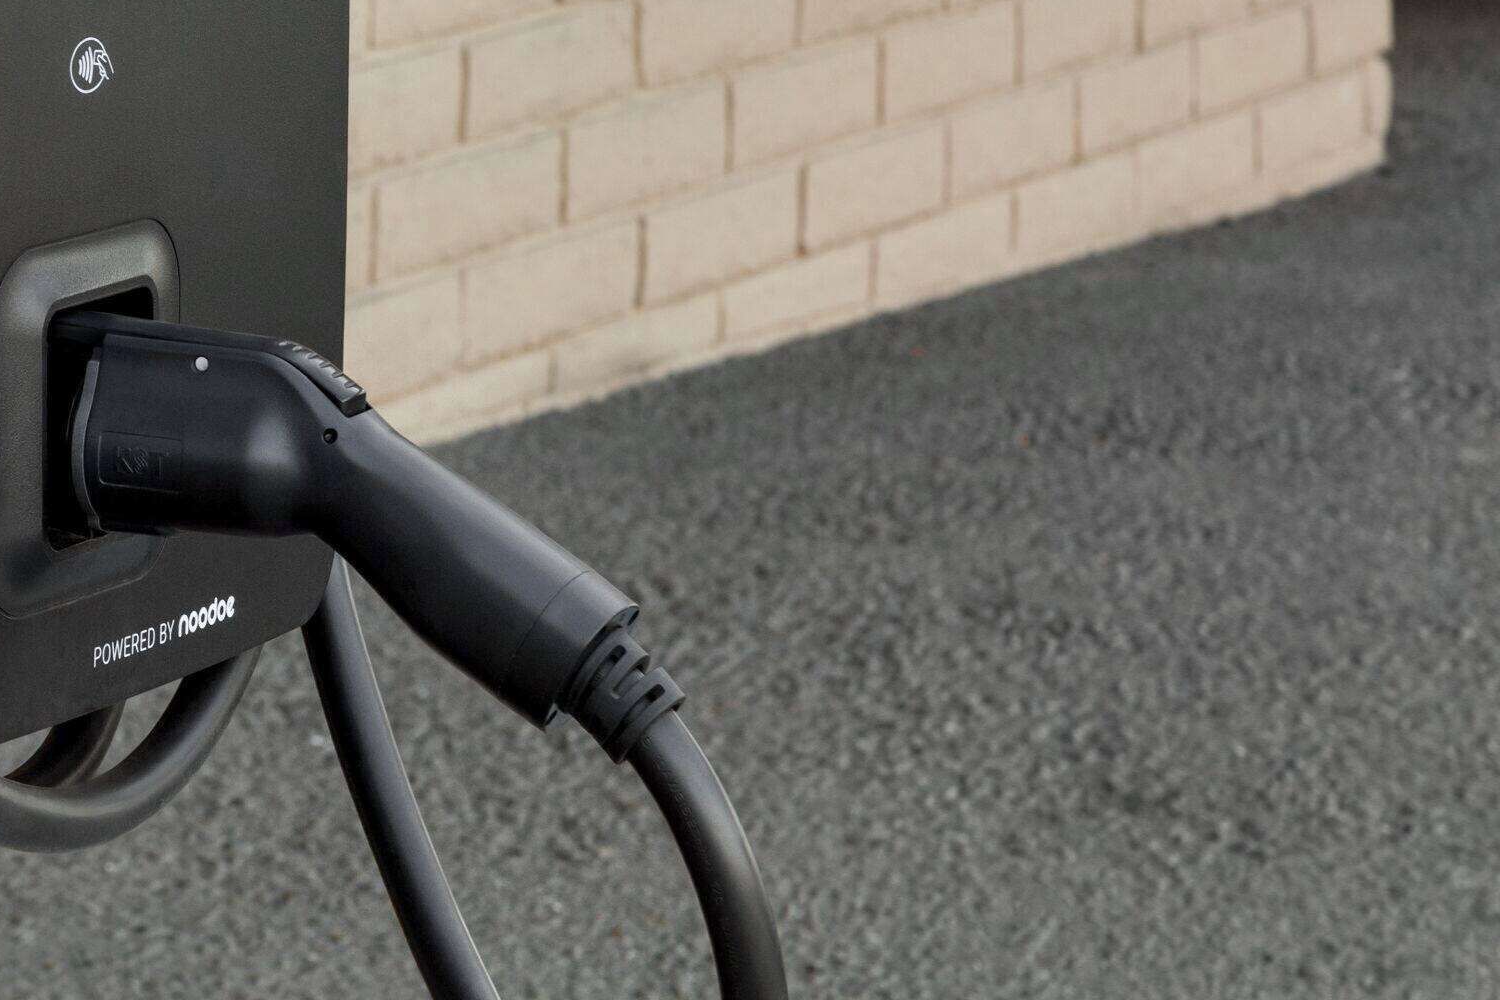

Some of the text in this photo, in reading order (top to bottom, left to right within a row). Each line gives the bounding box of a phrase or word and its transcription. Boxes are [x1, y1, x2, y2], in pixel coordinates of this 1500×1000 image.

[93, 595, 235, 668] POWERED BY noodoe
